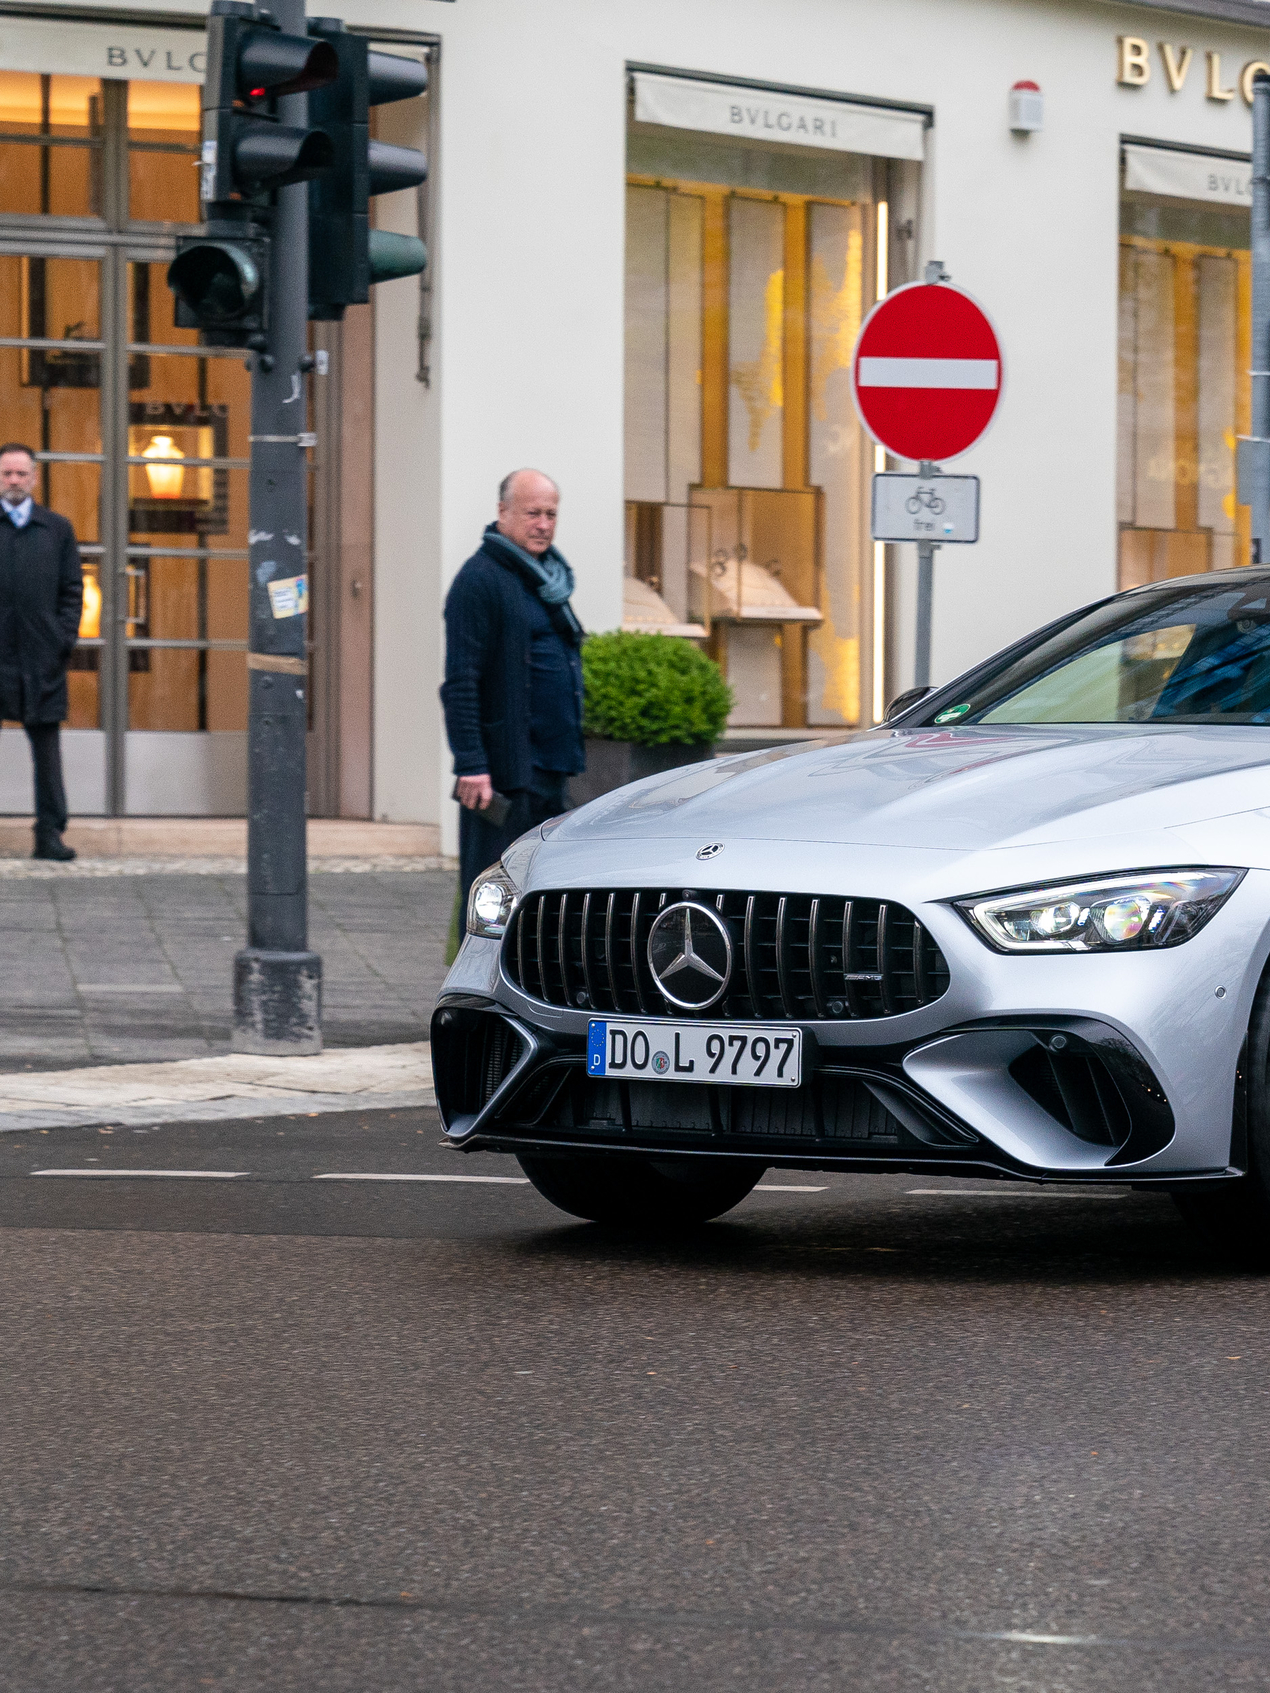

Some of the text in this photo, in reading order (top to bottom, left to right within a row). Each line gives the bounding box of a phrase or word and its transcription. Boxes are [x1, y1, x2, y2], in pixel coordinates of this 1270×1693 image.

[593, 1053, 601, 1066] D
[608, 1028, 650, 1071] DO
[673, 1031, 695, 1073] L
[705, 1033, 795, 1078] 9797
